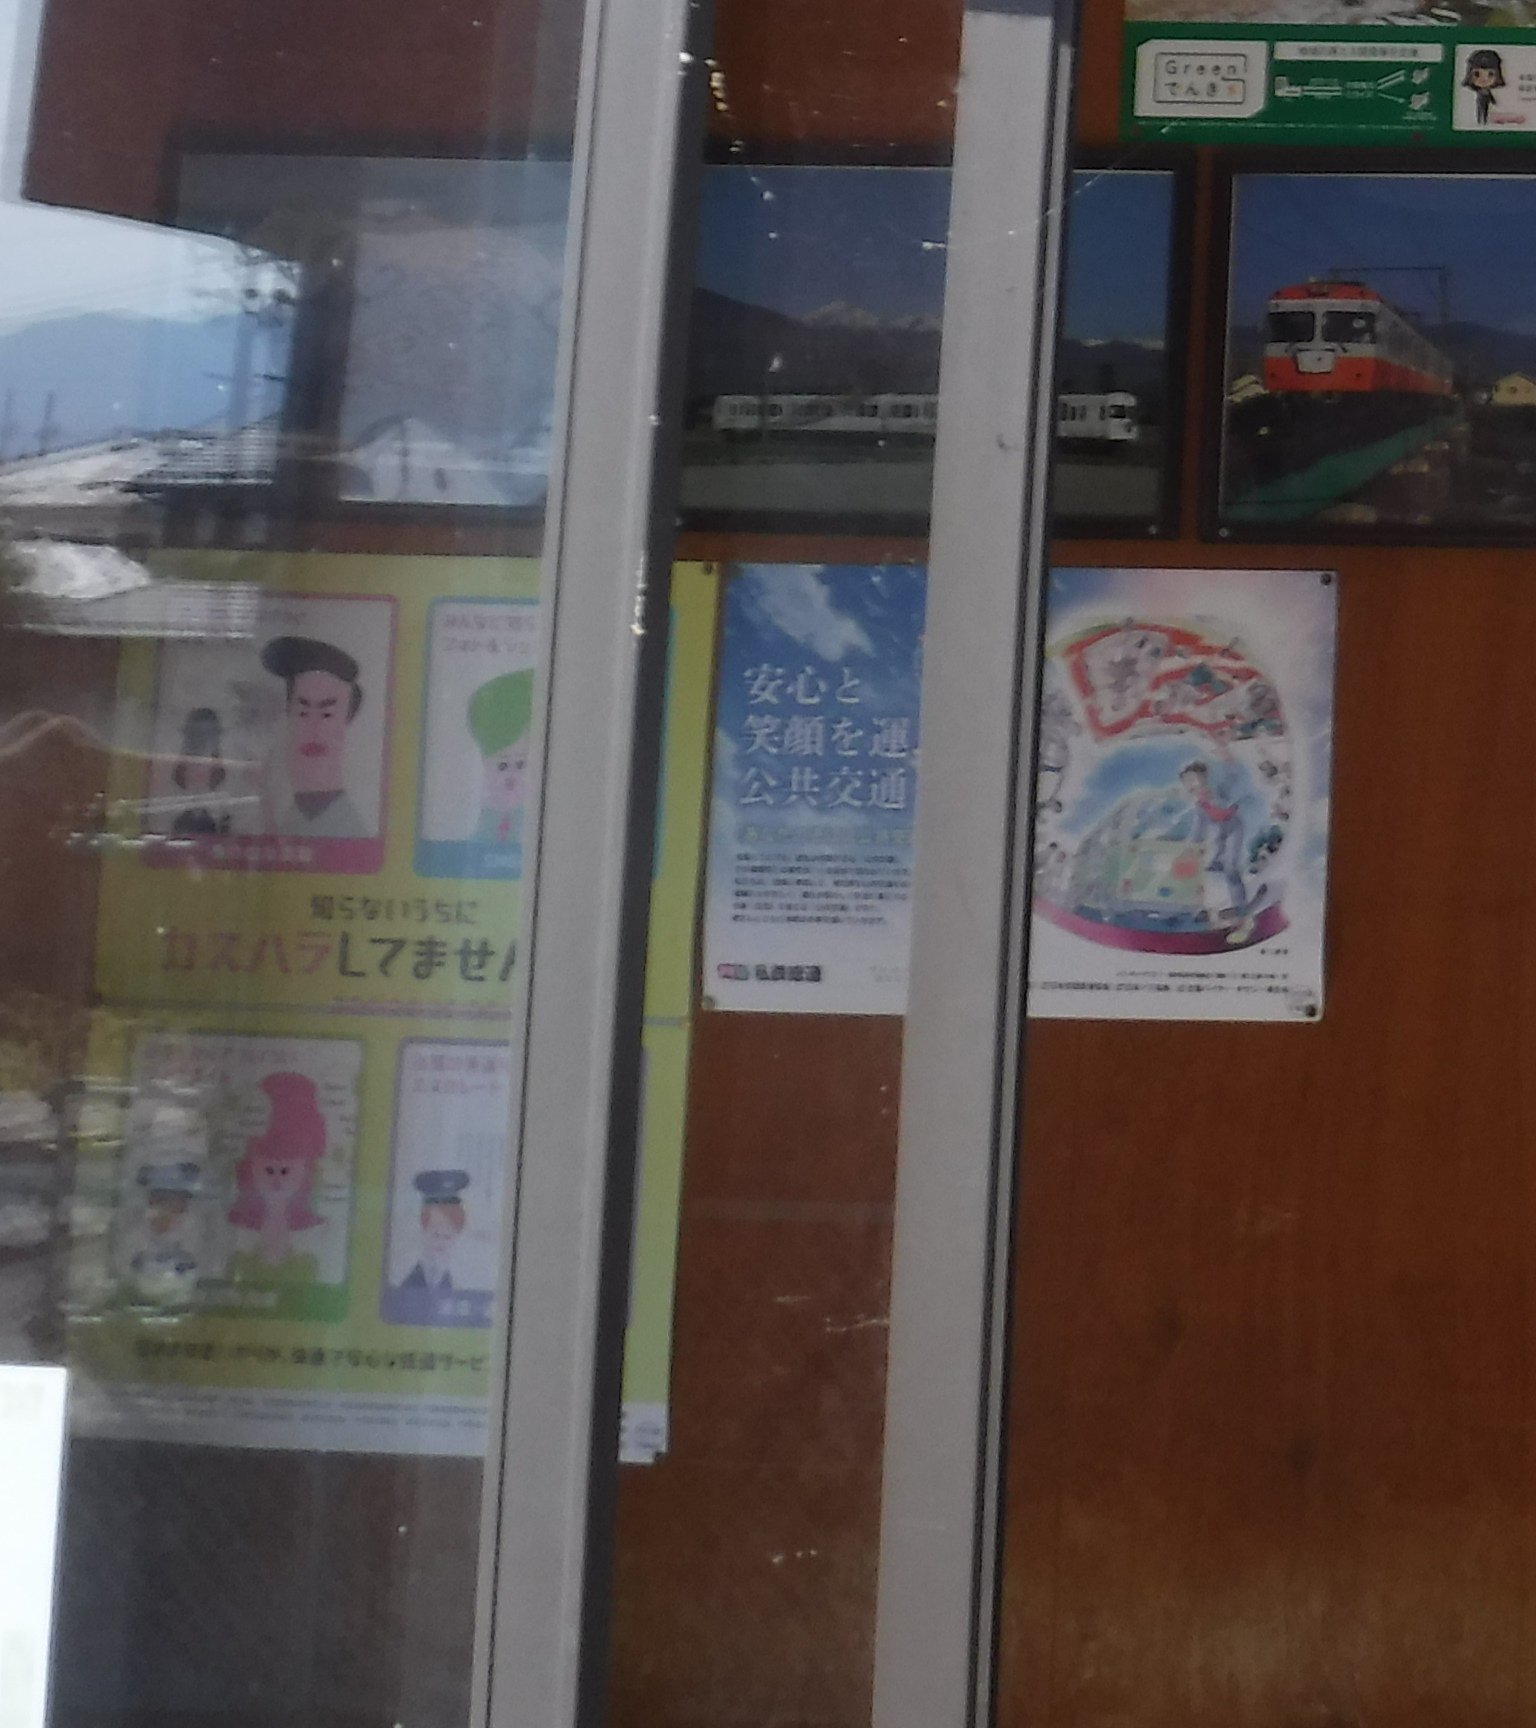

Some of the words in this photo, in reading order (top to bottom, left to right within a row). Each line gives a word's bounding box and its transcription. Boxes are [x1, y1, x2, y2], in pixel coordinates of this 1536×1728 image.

[743, 663, 860, 705] 安心と
[744, 714, 922, 759] 笑顔を運
[739, 765, 907, 810] 公共交通
